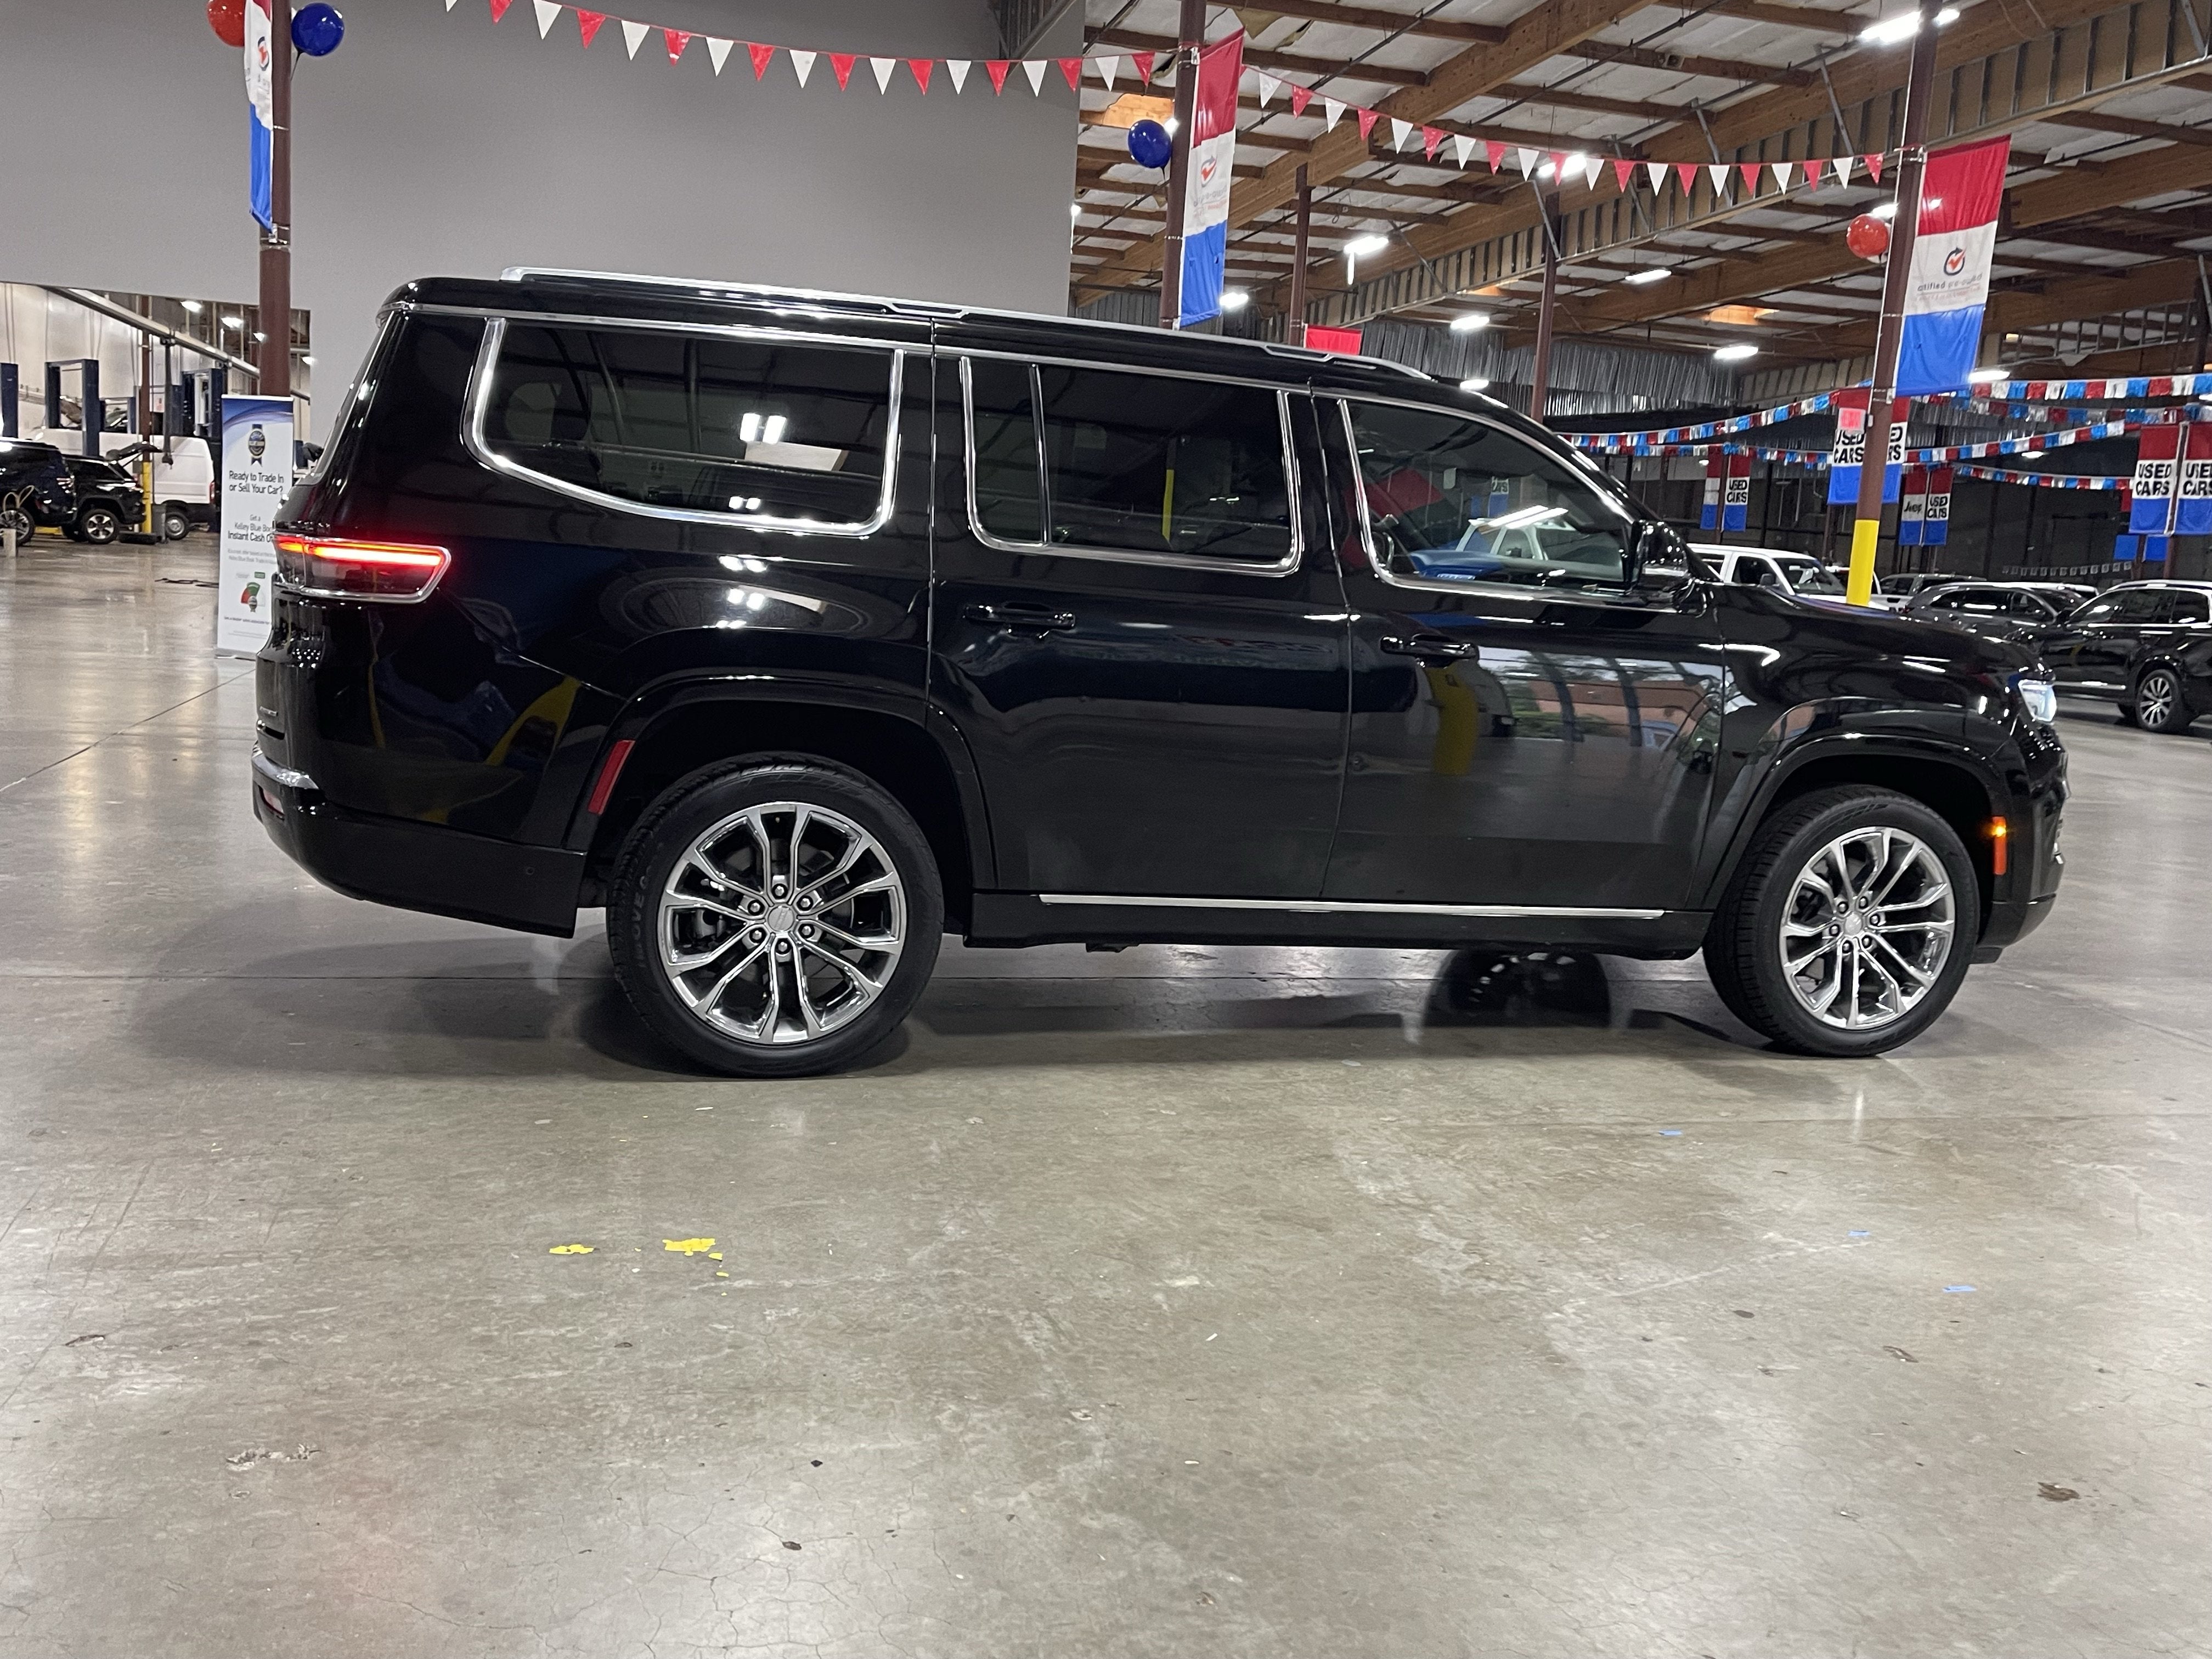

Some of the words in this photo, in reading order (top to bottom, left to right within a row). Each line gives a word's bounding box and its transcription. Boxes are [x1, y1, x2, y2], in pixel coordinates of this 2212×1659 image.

[1833, 447, 1864, 464] CARS
[229, 470, 249, 483] Ready
[250, 473, 257, 481] to
[258, 472, 276, 483] Trade
[278, 473, 284, 483] In
[2138, 462, 2172, 479] USED
[238, 483, 250, 493] Sell
[251, 484, 267, 493] Your
[267, 485, 283, 494] Car?
[1729, 479, 1748, 491] USED
[2136, 481, 2170, 496] CARS
[1726, 491, 1747, 504] CARS
[228, 531, 249, 541] Instant
[250, 532, 265, 542] Cash
